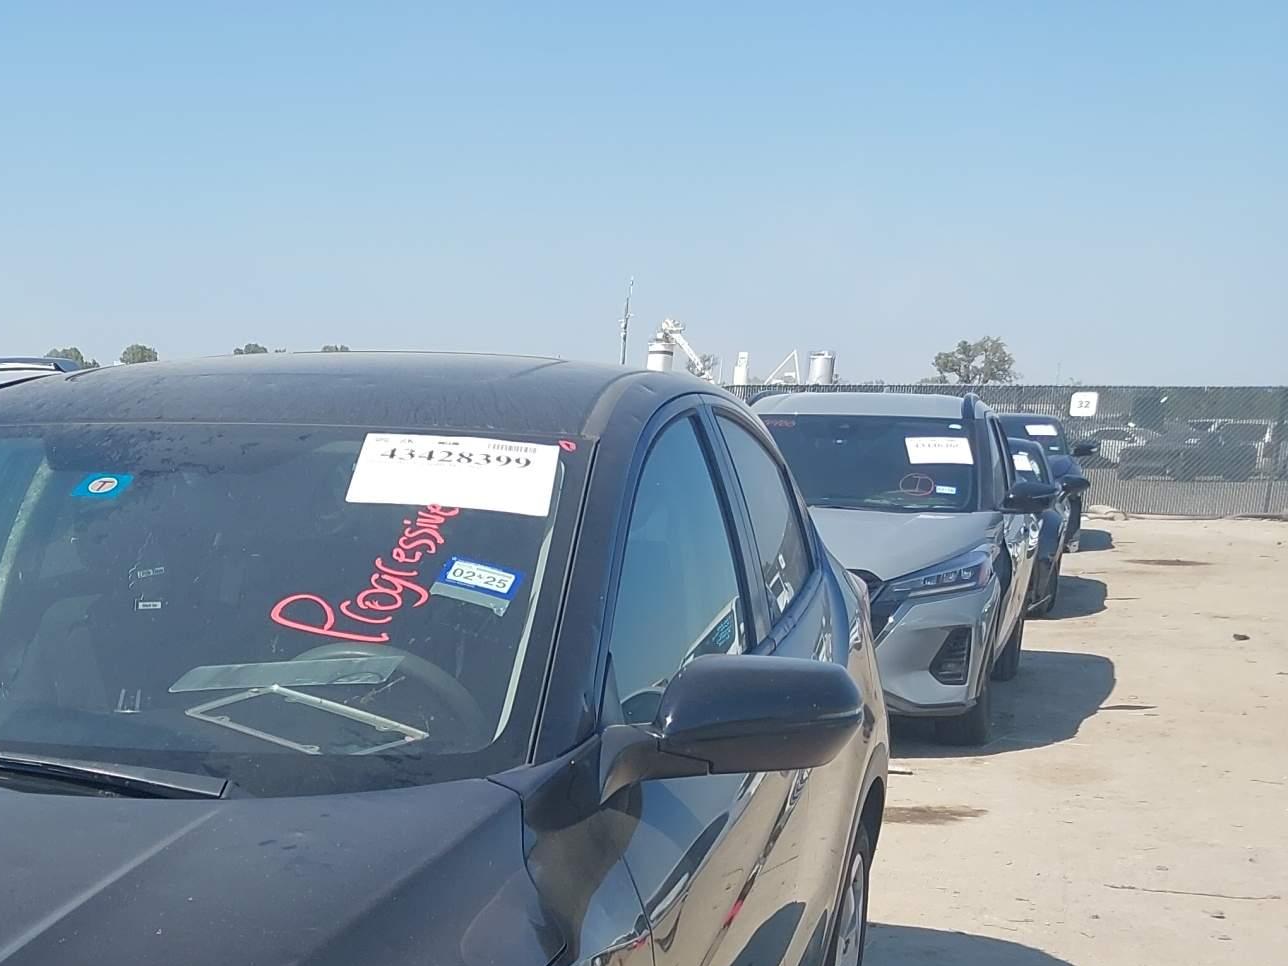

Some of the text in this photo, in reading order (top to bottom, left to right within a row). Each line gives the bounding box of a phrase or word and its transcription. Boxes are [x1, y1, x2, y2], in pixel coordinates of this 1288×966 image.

[1077, 400, 1091, 409] 32
[380, 446, 532, 469] 43428399
[270, 503, 459, 643] Progressive
[452, 567, 476, 581] 02
[483, 575, 509, 589] 25
